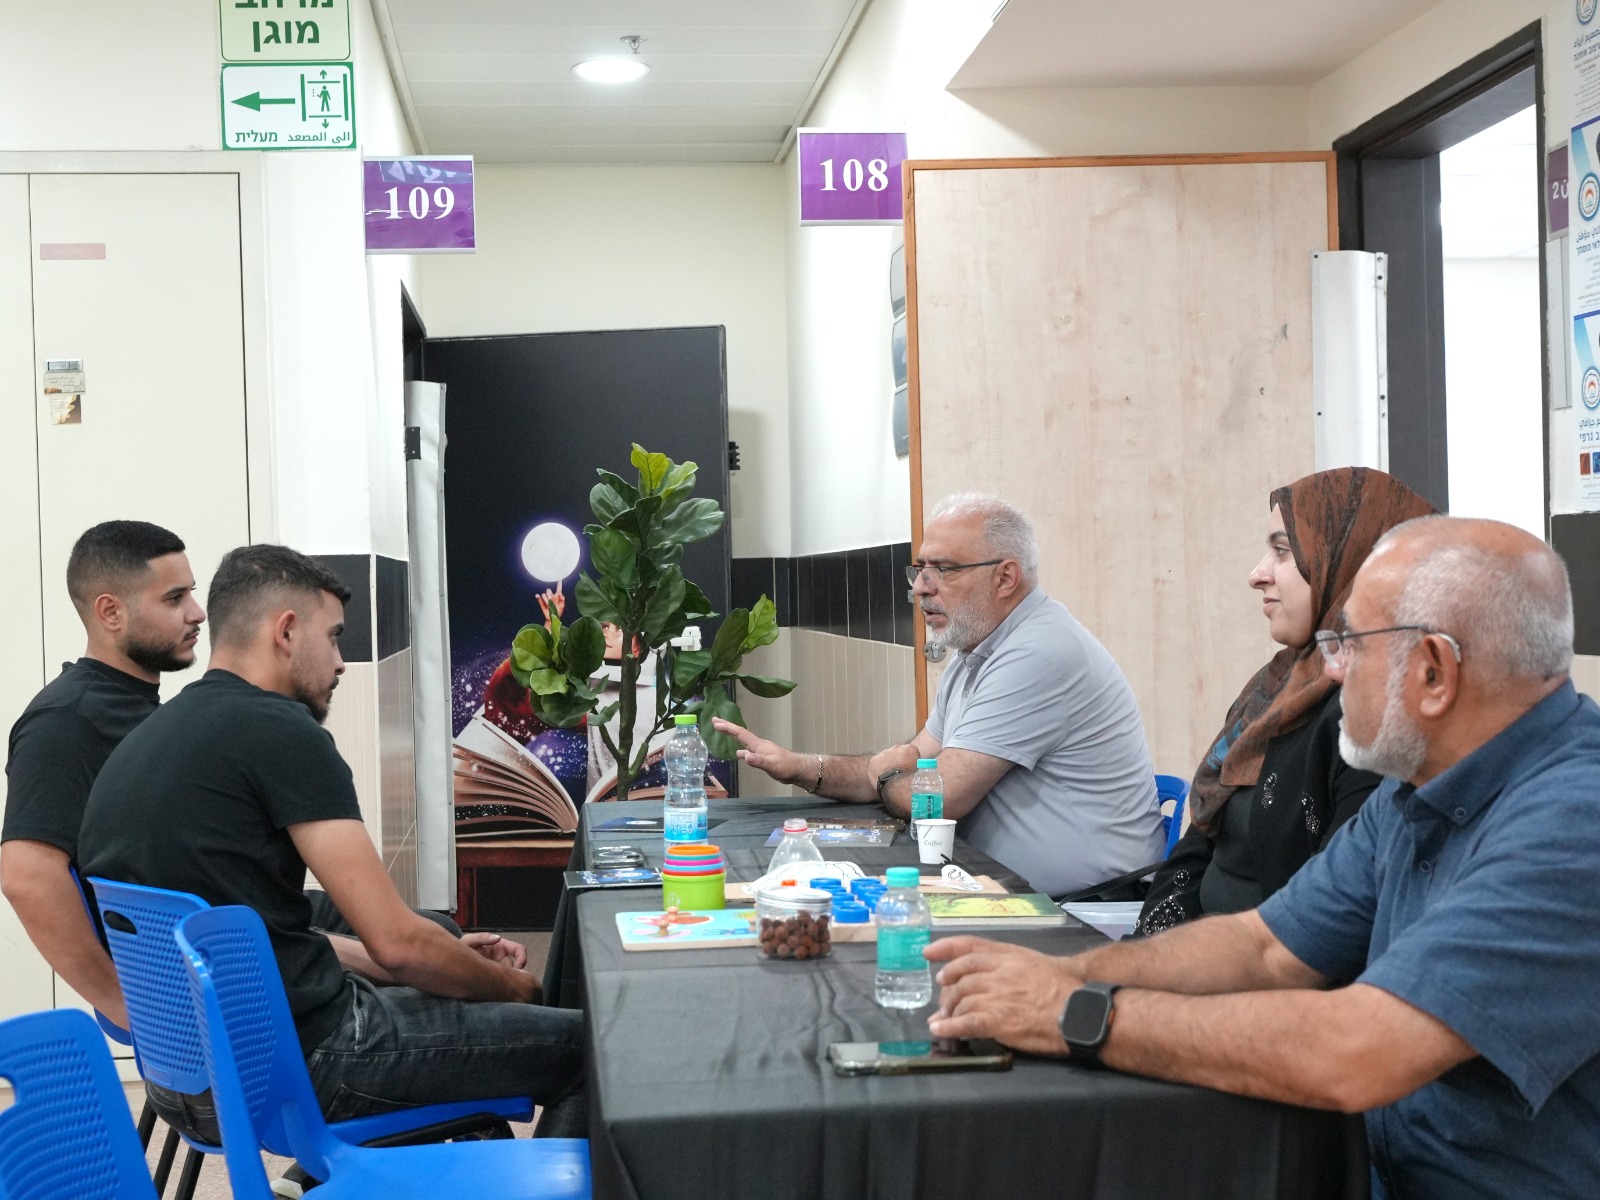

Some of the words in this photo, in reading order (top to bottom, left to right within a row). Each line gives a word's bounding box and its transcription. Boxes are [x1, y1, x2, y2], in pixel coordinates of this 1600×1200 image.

[252, 20, 320, 53] מוגן
[235, 129, 278, 143] מעלית
[287, 132, 327, 142] المصعد
[820, 158, 889, 192] 108
[384, 186, 455, 220] 109
